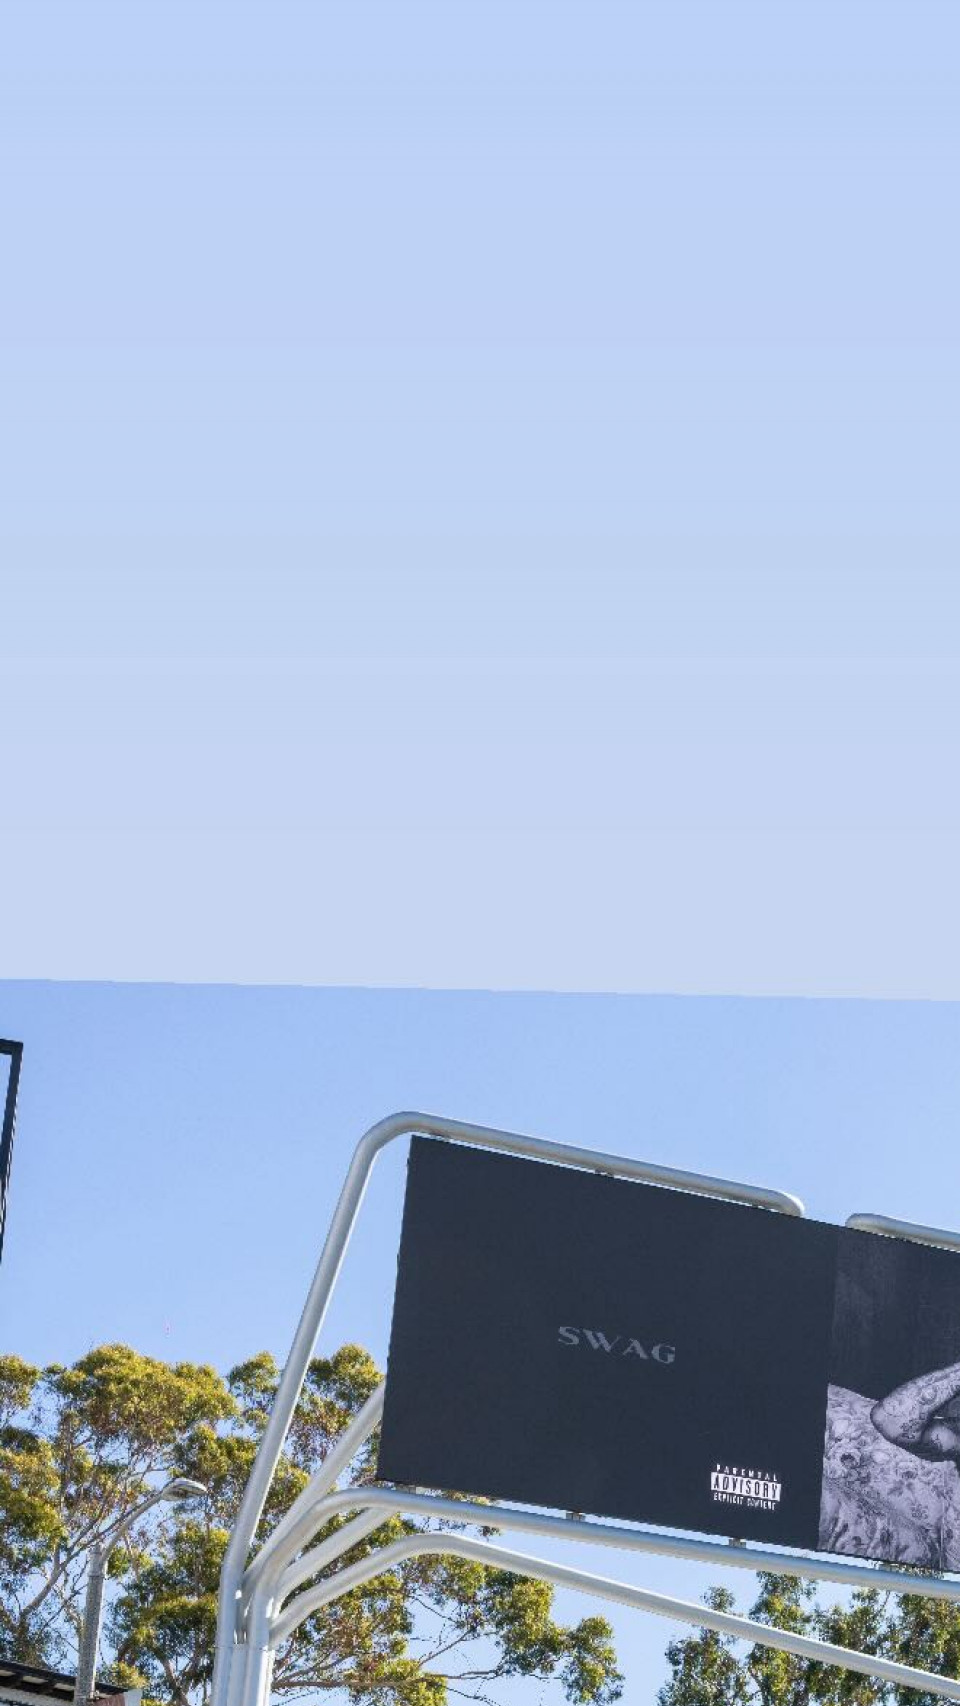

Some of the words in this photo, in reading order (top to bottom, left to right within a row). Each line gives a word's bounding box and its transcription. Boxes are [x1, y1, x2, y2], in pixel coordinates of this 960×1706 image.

[558, 1326, 676, 1364] SWAG
[716, 1463, 778, 1482] PARENTAL
[713, 1473, 778, 1499] ADVISORY
[713, 1492, 743, 1505] EXPLICIT
